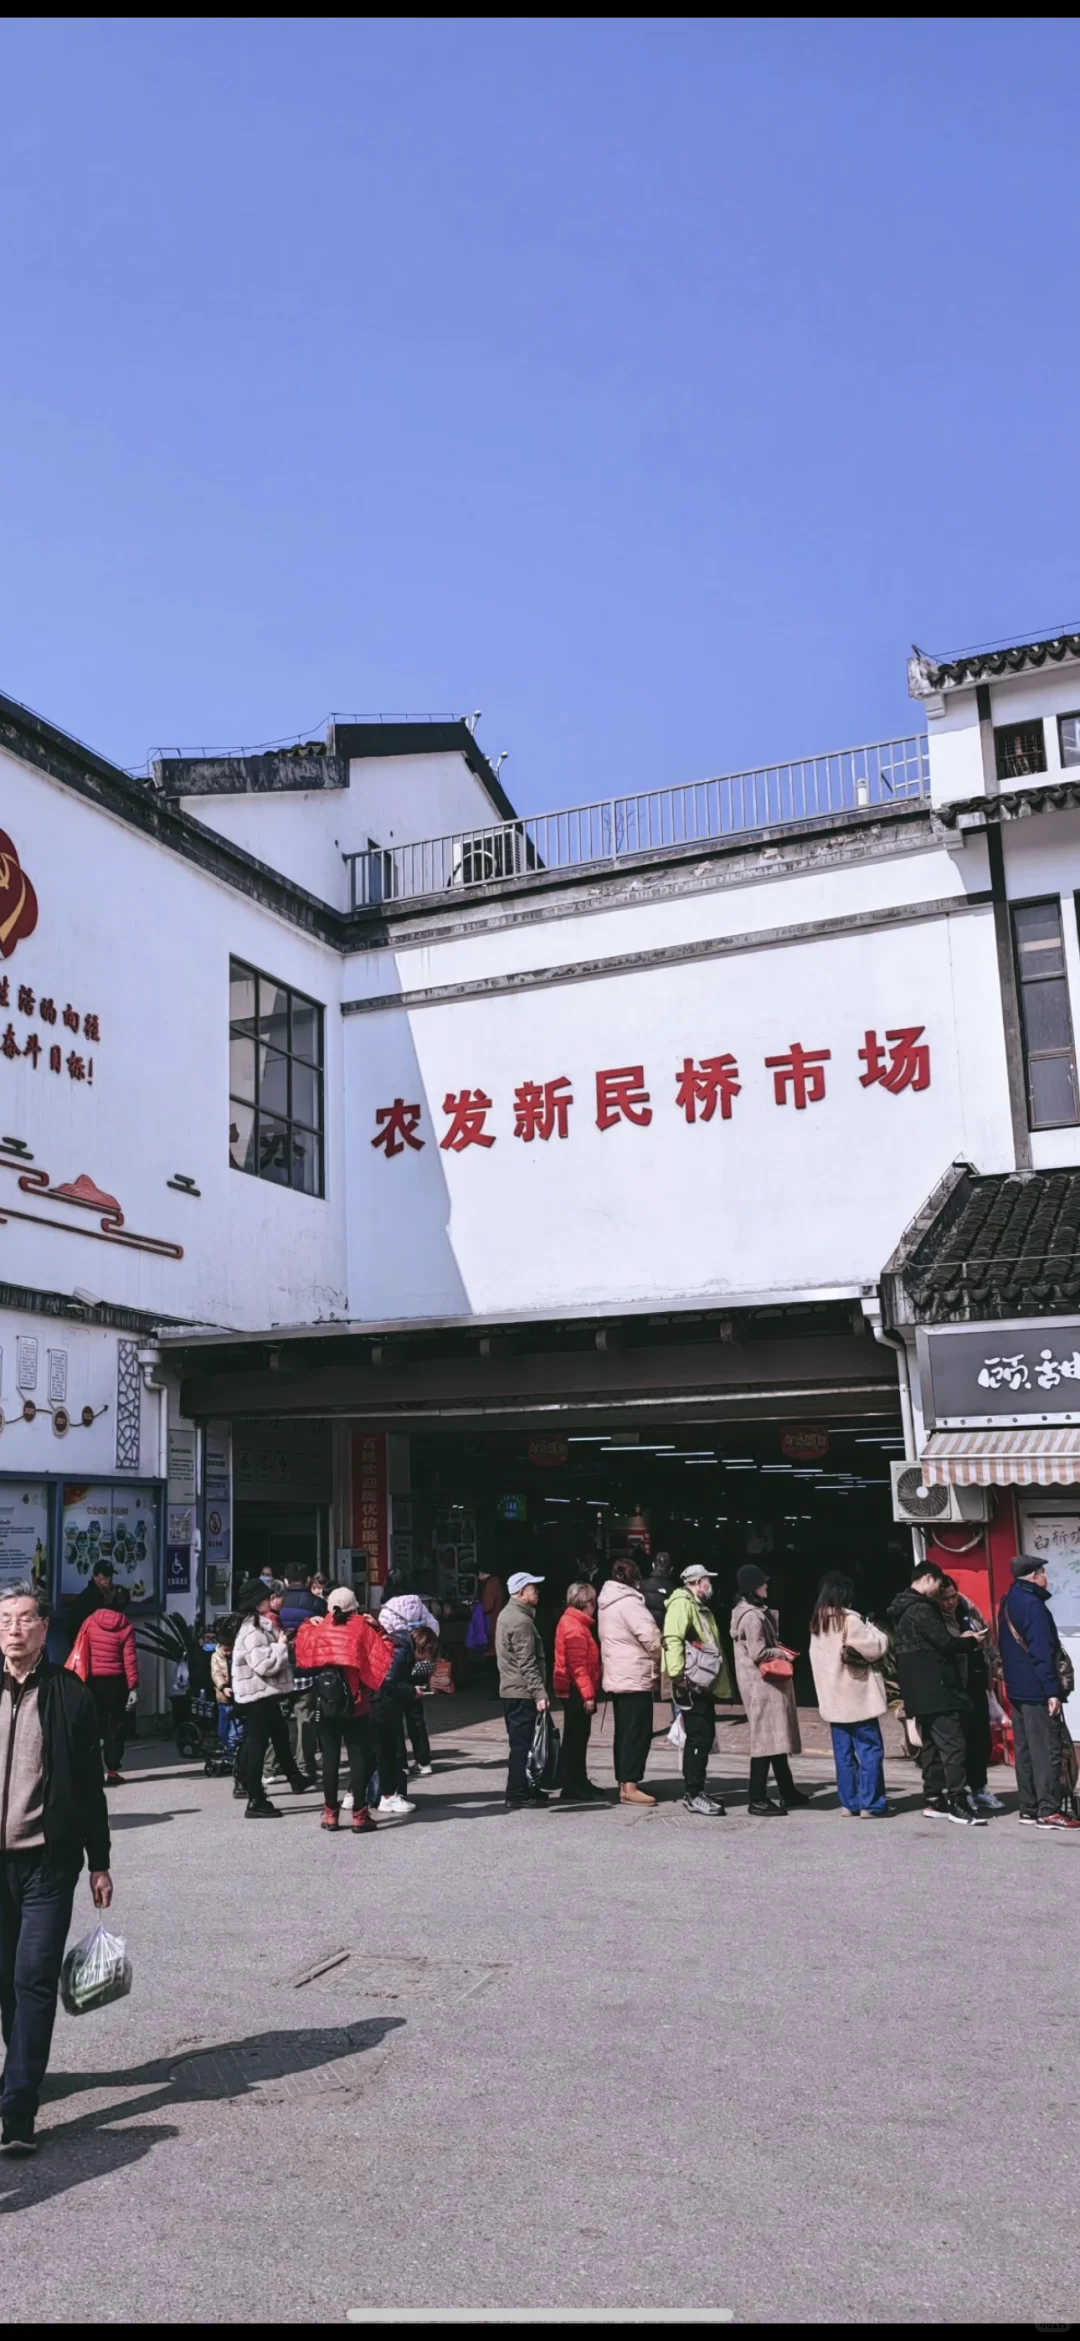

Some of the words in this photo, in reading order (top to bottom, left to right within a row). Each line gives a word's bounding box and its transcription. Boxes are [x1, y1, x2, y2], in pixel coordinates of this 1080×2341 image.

[370, 1025, 933, 1160] 农发新民桥市场
